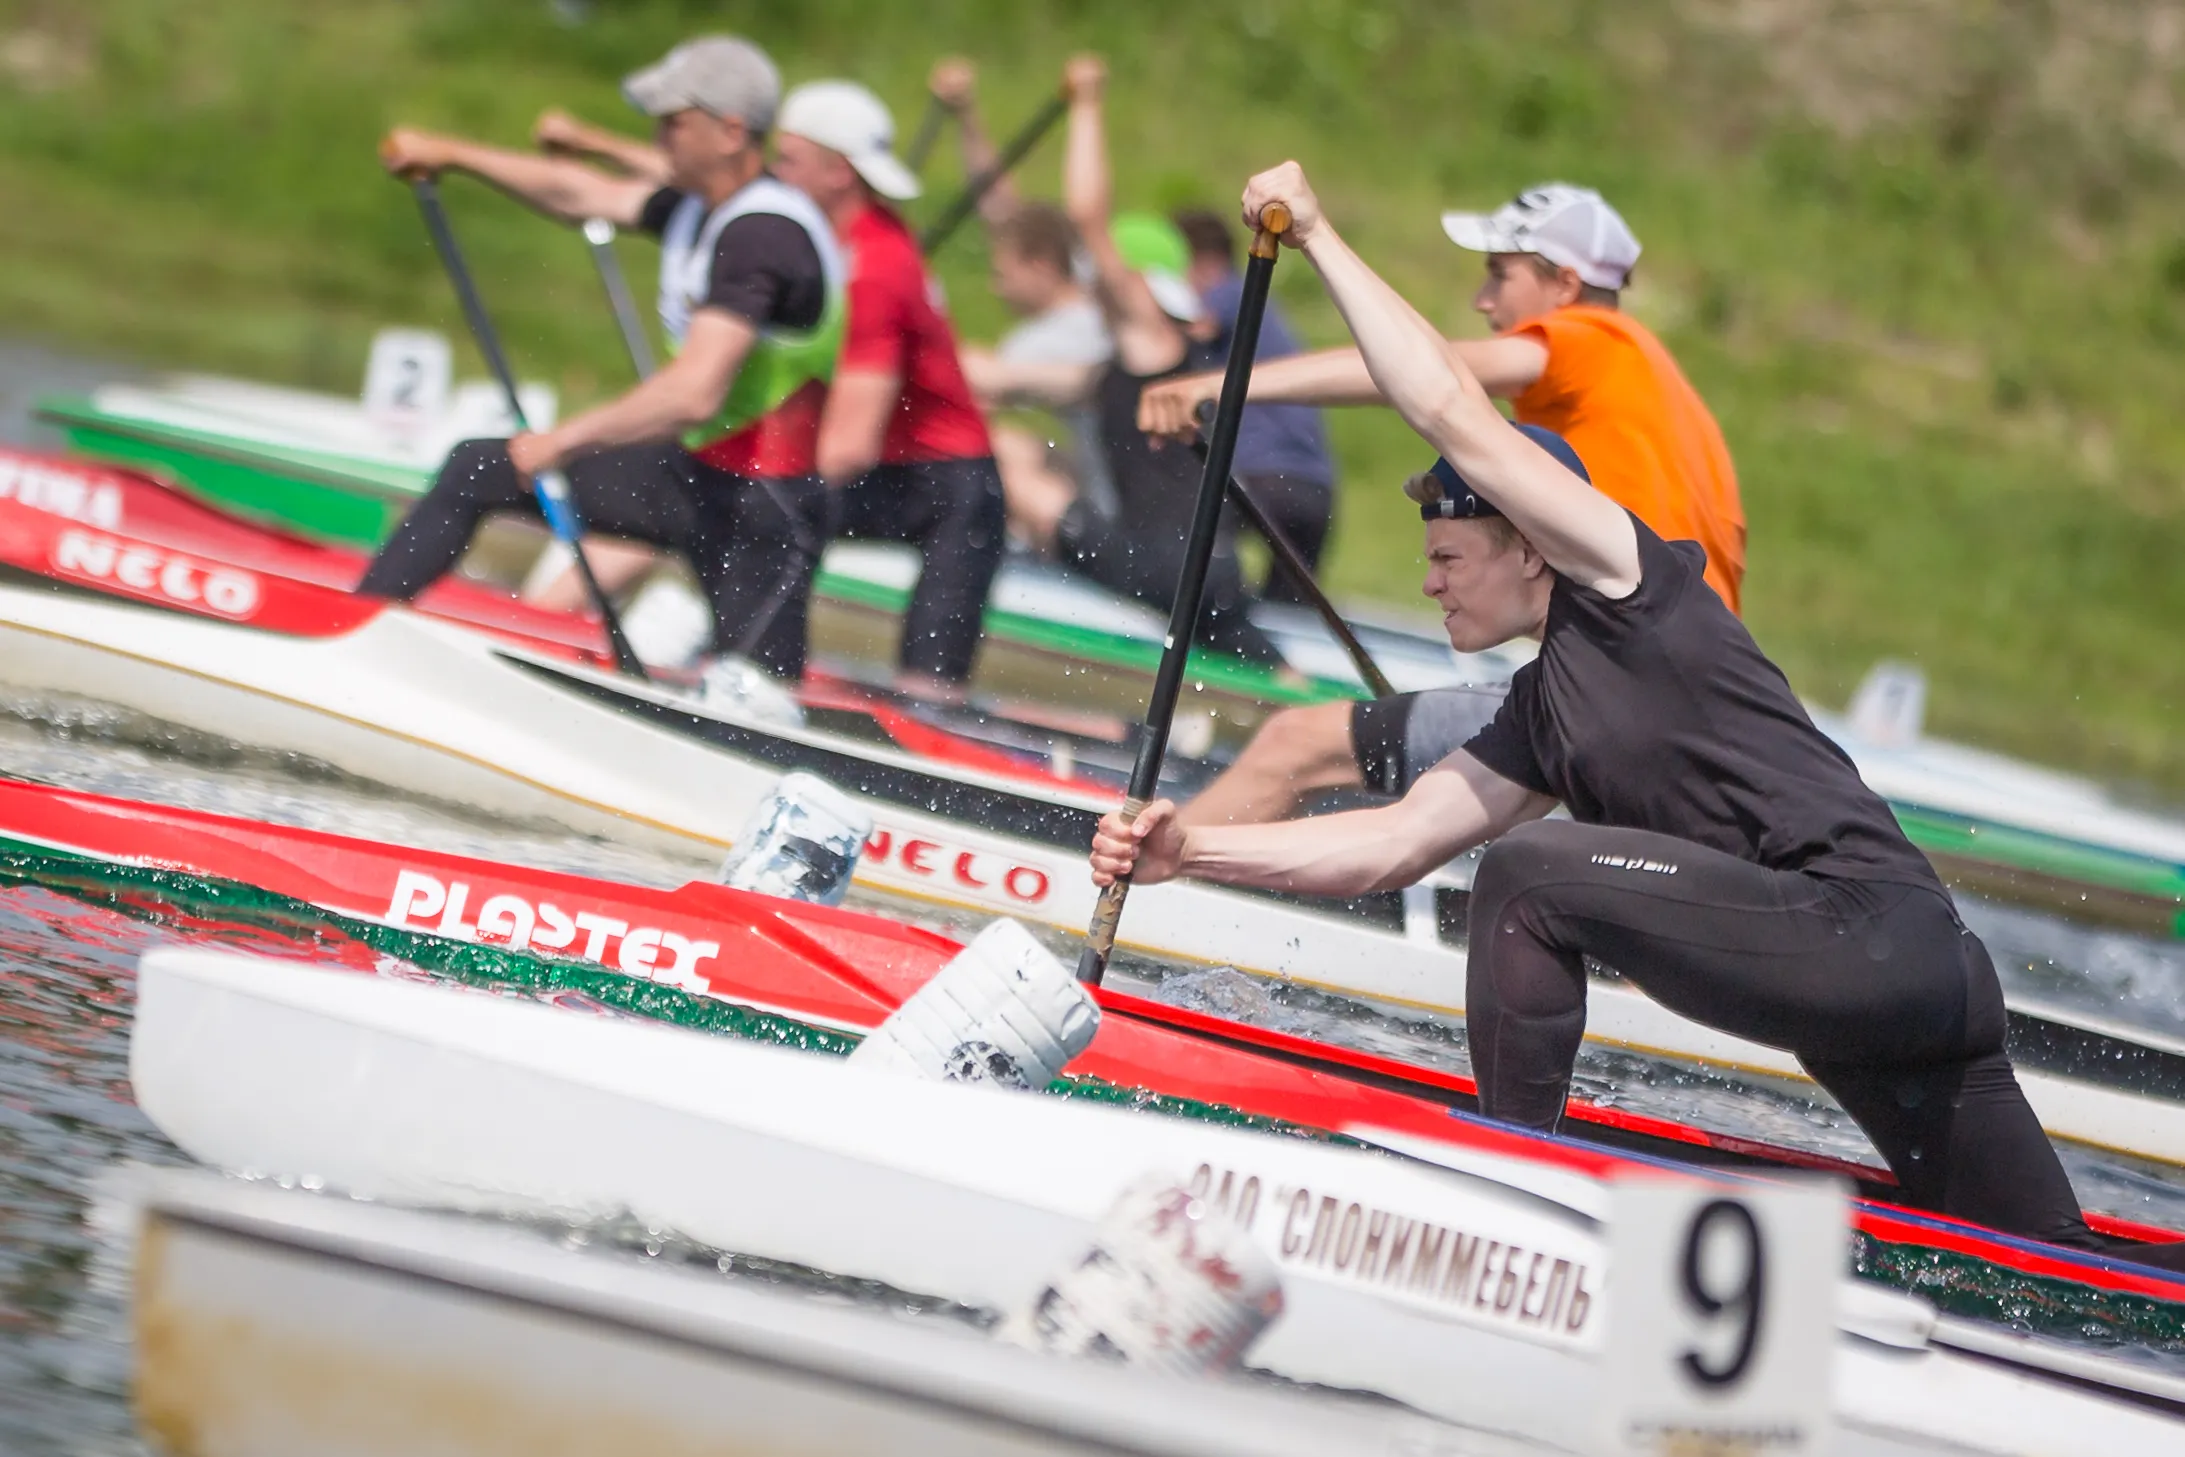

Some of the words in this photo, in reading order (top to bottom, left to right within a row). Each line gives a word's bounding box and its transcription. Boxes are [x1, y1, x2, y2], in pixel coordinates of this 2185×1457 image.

[57, 532, 259, 616] NELO
[384, 869, 720, 994] PLASTEX
[1676, 1197, 1765, 1388] 9
